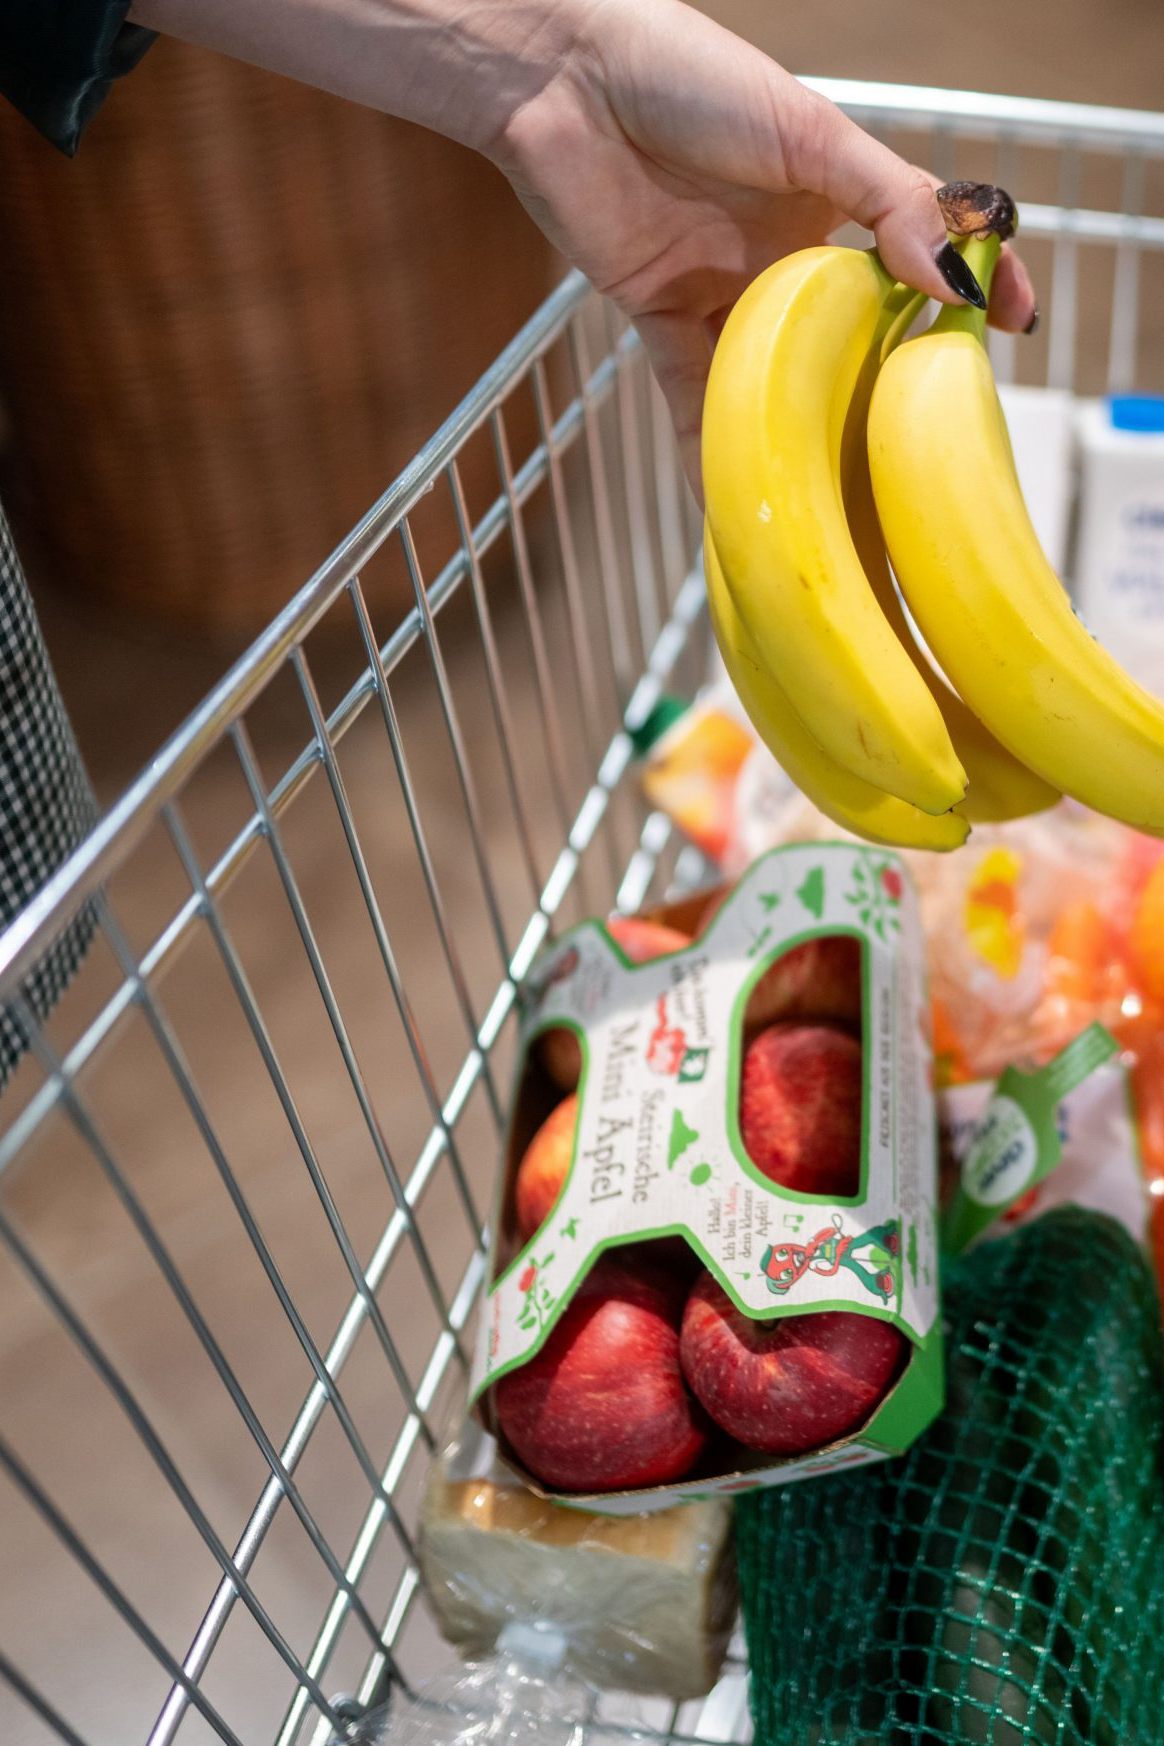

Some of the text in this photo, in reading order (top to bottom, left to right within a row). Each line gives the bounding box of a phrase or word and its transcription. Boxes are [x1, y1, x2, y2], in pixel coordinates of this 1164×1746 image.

[583, 1020, 640, 1205] Mini Äpfel
[632, 1088, 666, 1204] Steirische
[707, 1196, 721, 1234] Hallo!
[722, 1219, 737, 1239] bin
[738, 1189, 754, 1259] dein kleiner
[754, 1200, 774, 1237] Apfel!
[722, 1241, 736, 1261] Ich
